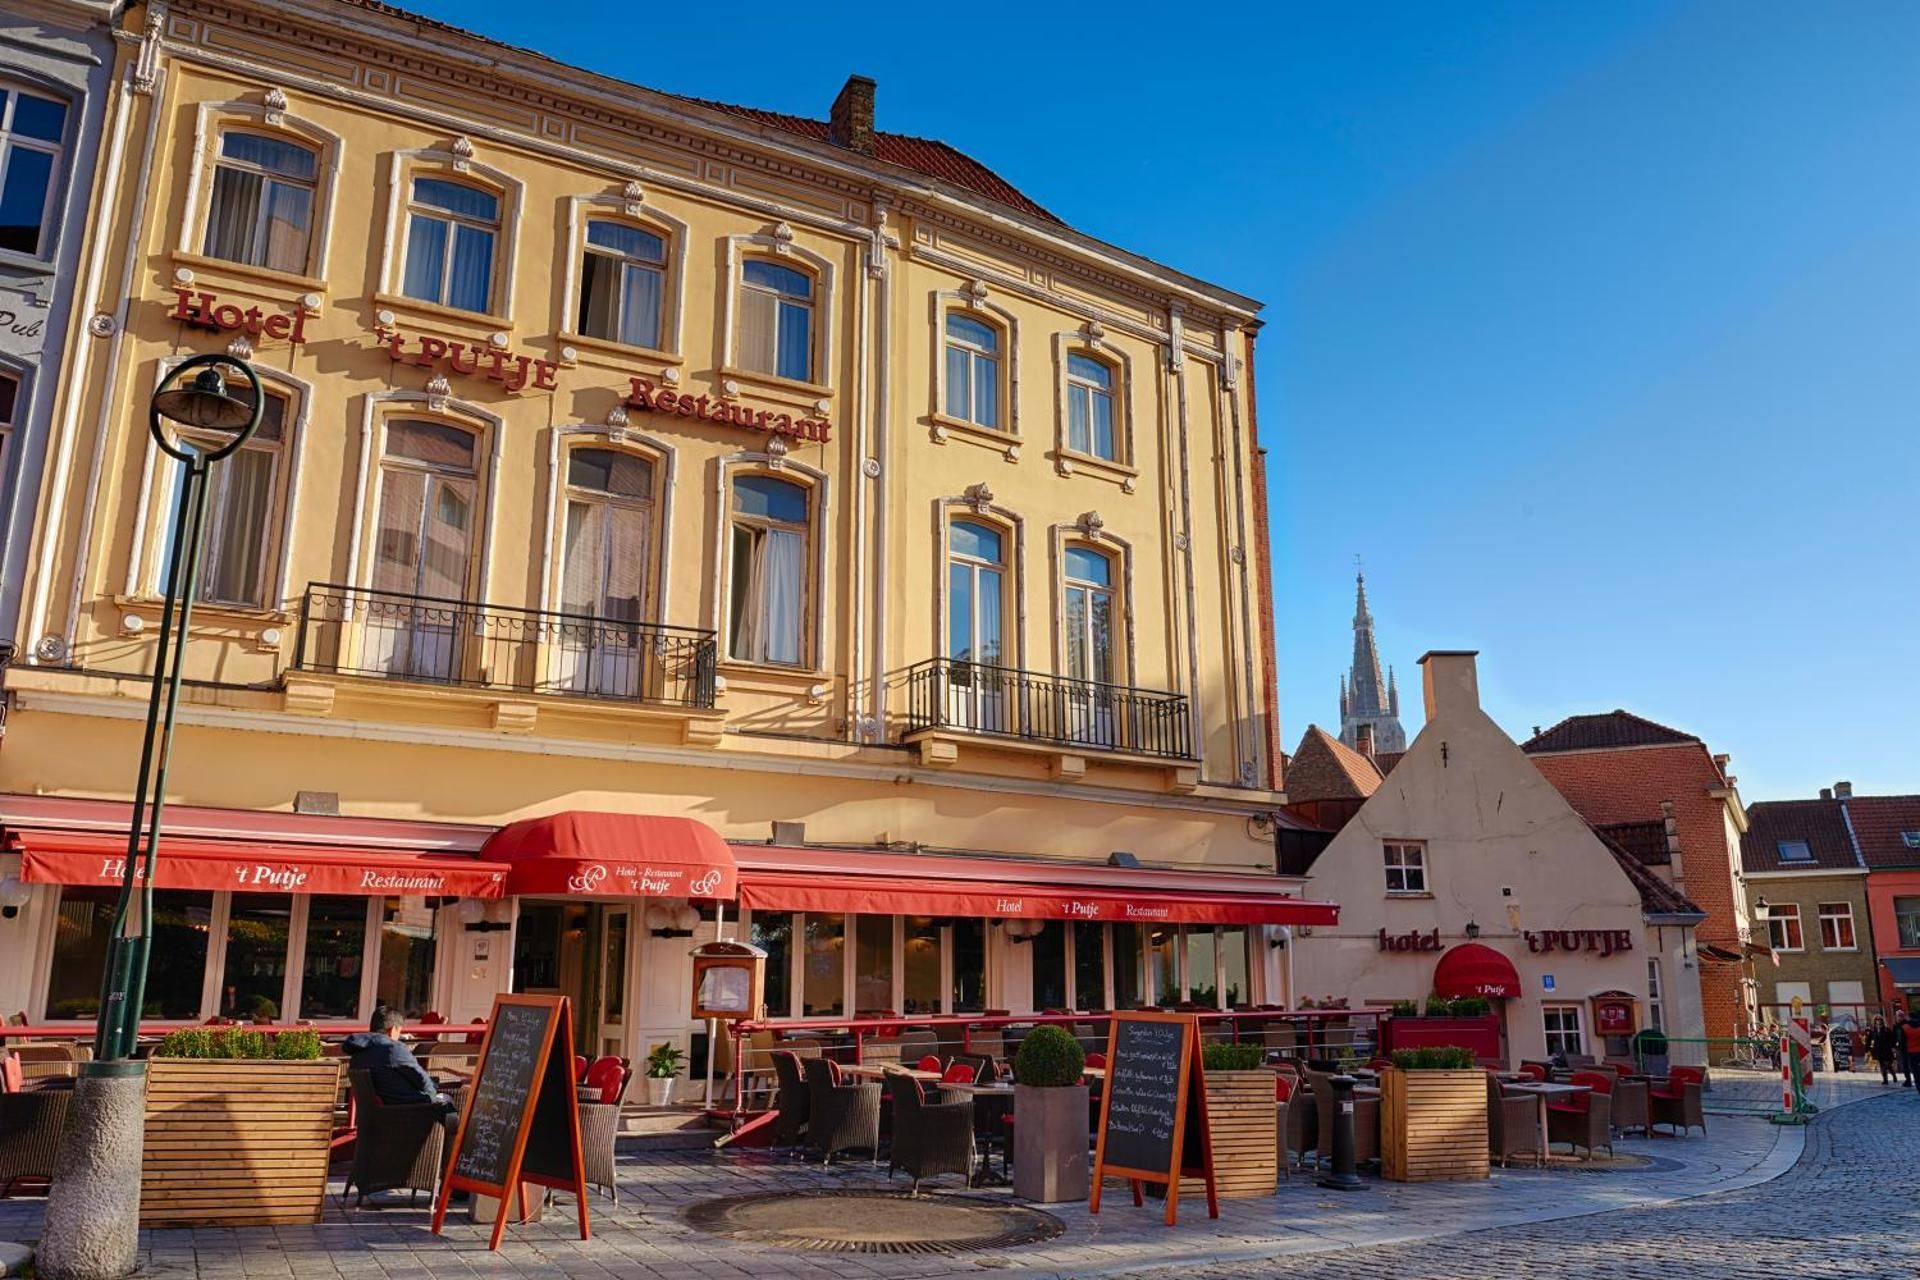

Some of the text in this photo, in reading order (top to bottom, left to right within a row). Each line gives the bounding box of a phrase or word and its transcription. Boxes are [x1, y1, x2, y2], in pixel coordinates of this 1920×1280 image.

[171, 289, 306, 343] Hotel
[415, 336, 560, 391] PUTJE
[626, 377, 832, 443] Restaurant
[252, 865, 307, 889] Putje
[360, 870, 446, 889] Restaurant
[640, 878, 670, 894] Putje
[996, 898, 1023, 913] Hotel
[1072, 902, 1099, 918] Putje
[1126, 903, 1168, 917] Restaurant
[1379, 927, 1445, 951] hotel
[1540, 930, 1633, 957] PUTJE
[1484, 984, 1505, 996] Putje
